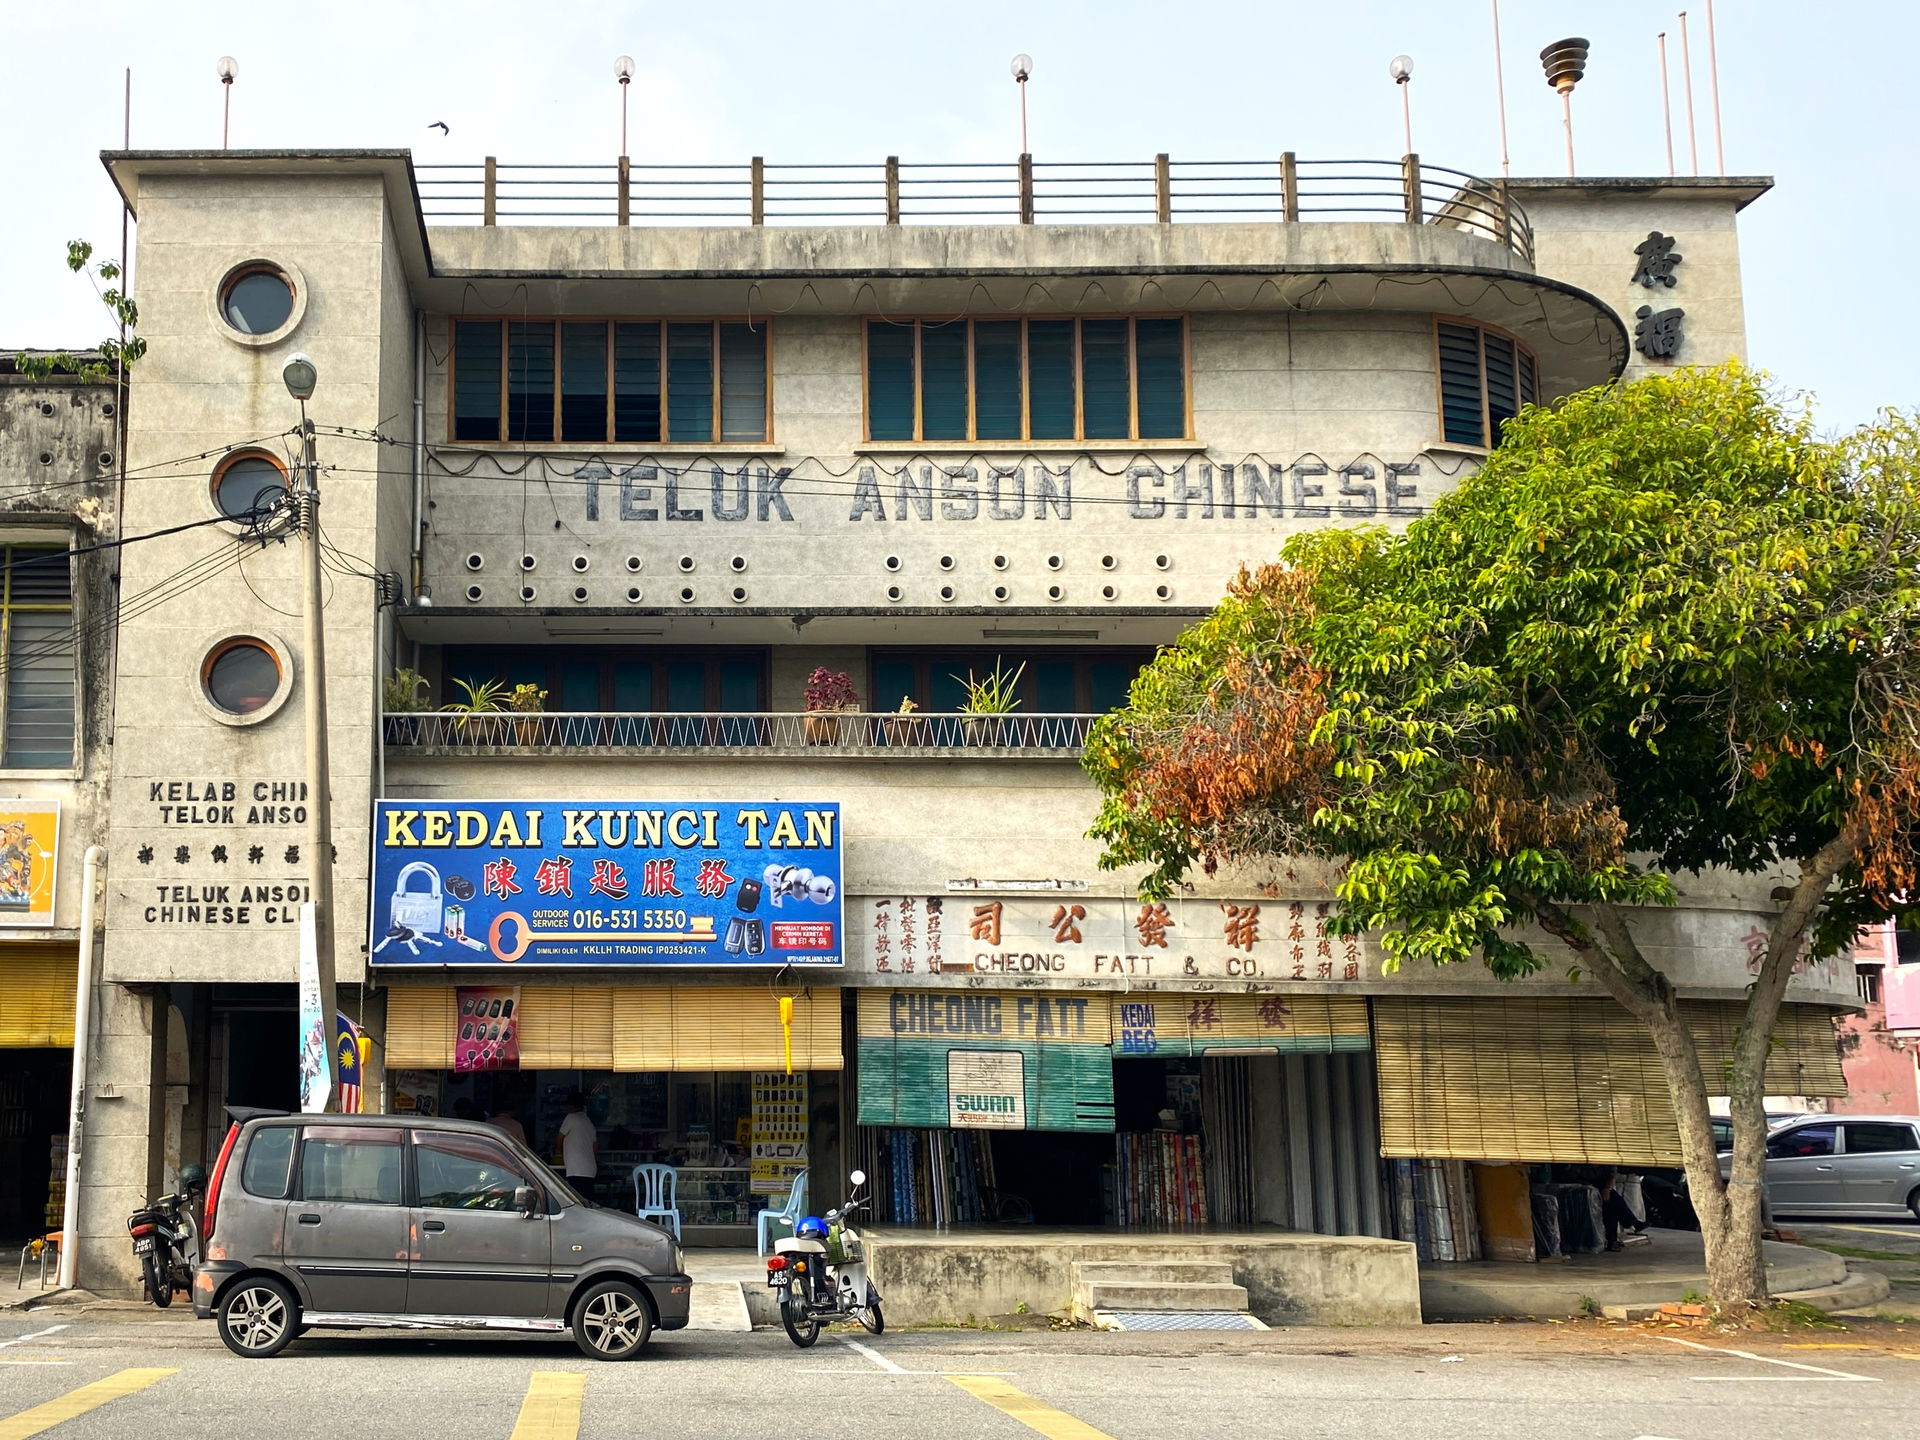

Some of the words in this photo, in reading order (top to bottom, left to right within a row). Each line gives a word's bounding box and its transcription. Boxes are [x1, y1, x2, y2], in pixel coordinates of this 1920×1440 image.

[575, 466, 794, 522] TELUK
[849, 464, 1072, 522] ANSON
[1127, 462, 1421, 520] CHINESE
[150, 782, 236, 802] KELAB
[254, 782, 332, 802] CHIN
[160, 806, 234, 824] TELOK
[247, 806, 307, 824] ANSO
[384, 809, 544, 848] KEDAI
[562, 809, 719, 848] KUNCI
[737, 810, 834, 849] TAN
[483, 854, 736, 900] 陳鎖匙服務
[157, 886, 230, 903] TELUK
[144, 906, 250, 924] CHINESE
[264, 907, 300, 923] CL
[533, 910, 569, 918] OUTDOOR
[573, 910, 638, 929] 016-531
[643, 910, 687, 929] 5350
[583, 946, 612, 954] KKLLH
[615, 946, 653, 954] TRADING
[974, 953, 1065, 971] CHEONG
[1094, 956, 1154, 974] FATT
[1183, 957, 1200, 975] &
[890, 993, 1002, 1035] CHEONG
[1017, 997, 1089, 1037] FATT
[1121, 1004, 1155, 1028] KEDAI
[1122, 1030, 1156, 1053] BEG
